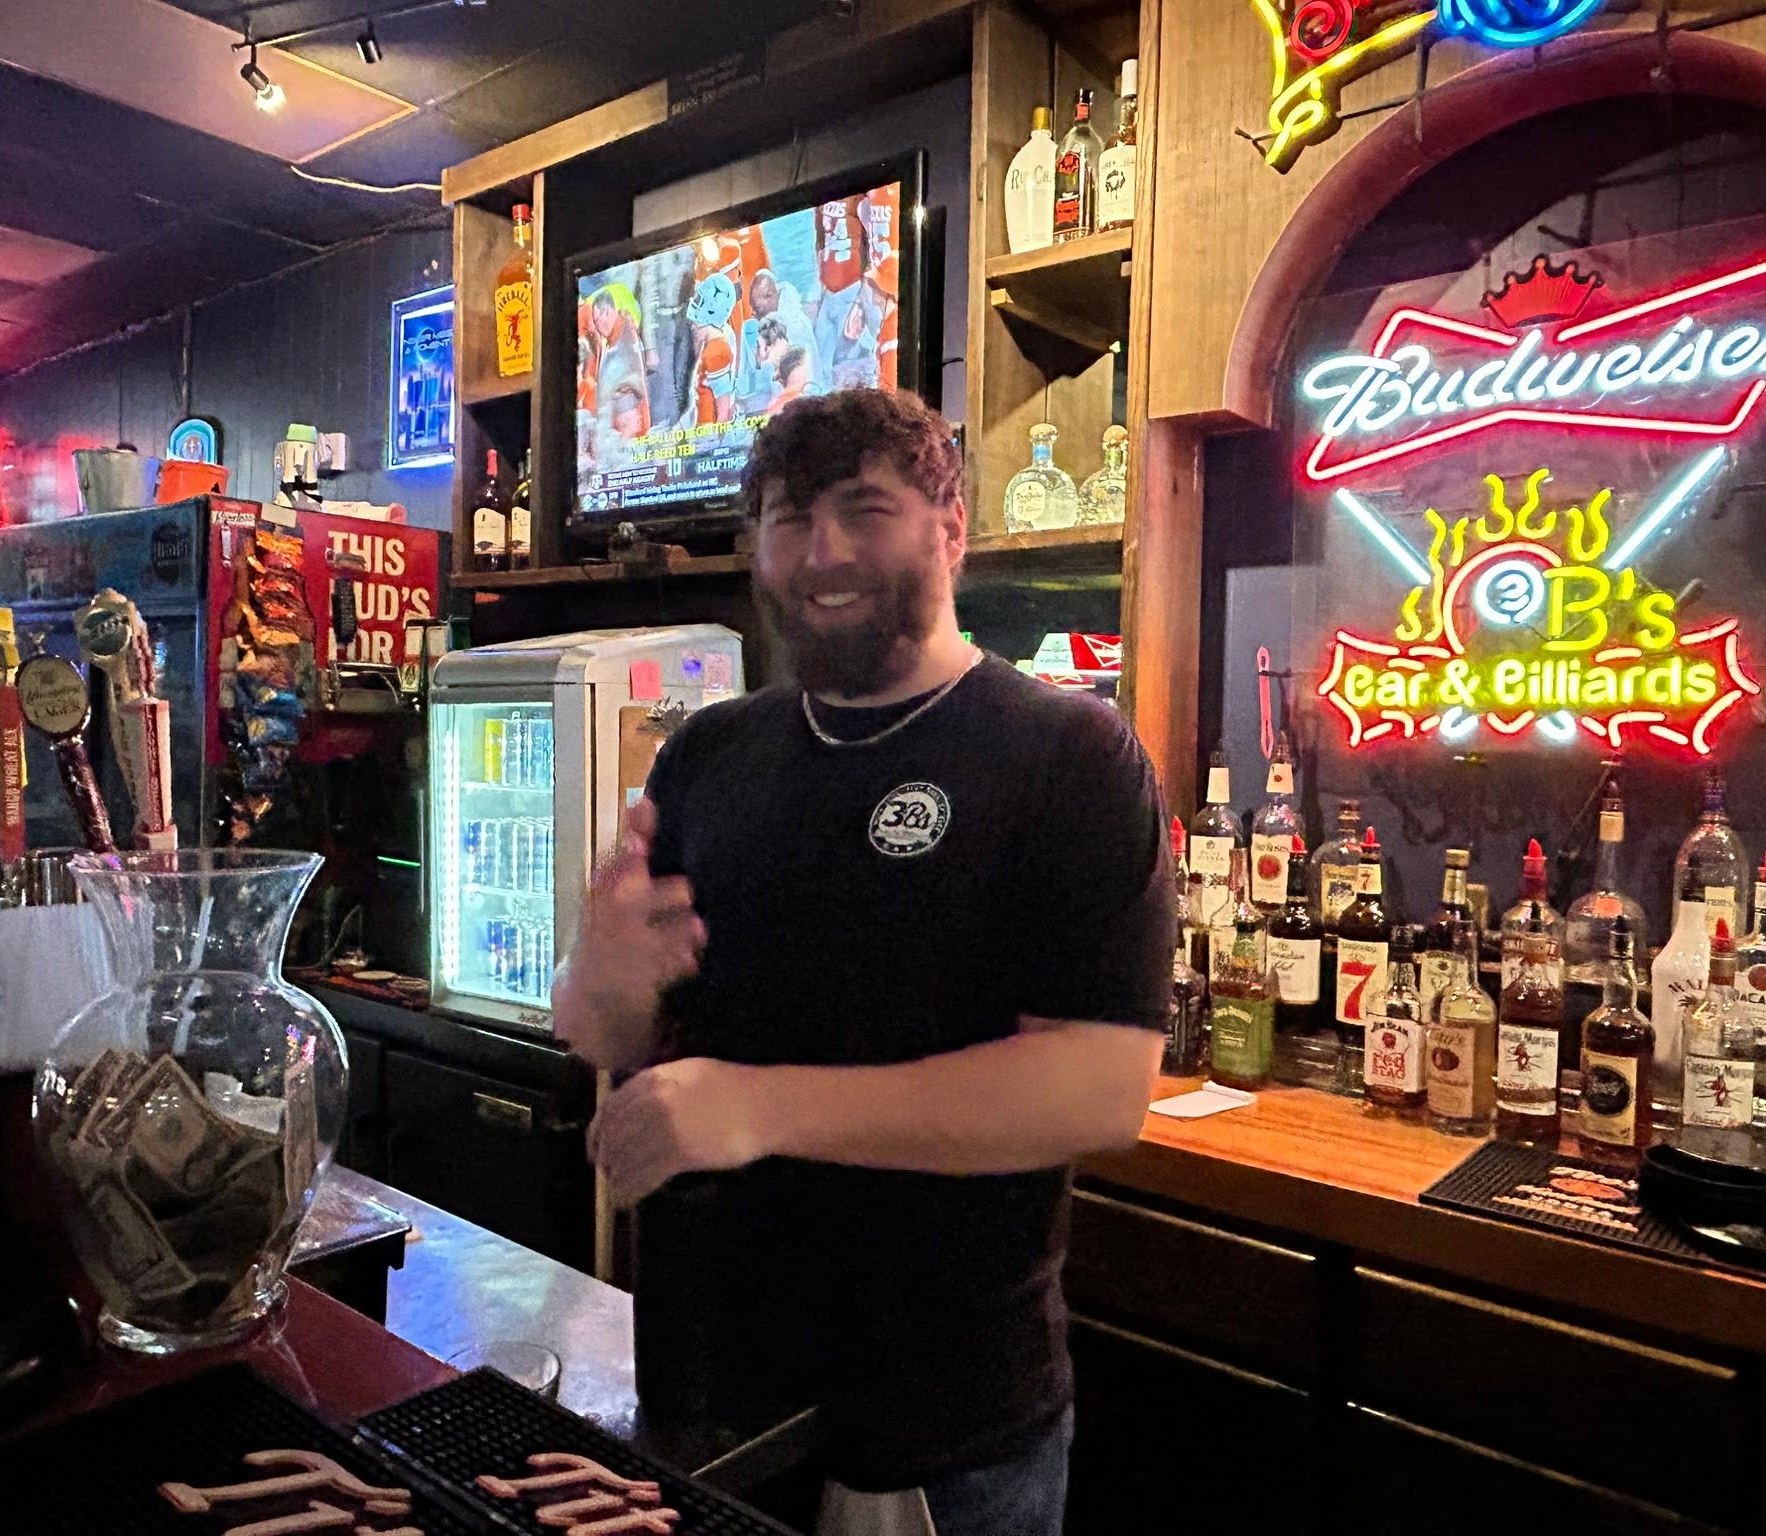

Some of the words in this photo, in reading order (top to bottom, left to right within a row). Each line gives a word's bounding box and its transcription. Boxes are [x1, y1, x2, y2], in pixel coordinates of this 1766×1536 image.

[1302, 317, 1766, 437] Budweise
[328, 531, 405, 576] THIS
[1438, 658, 1480, 706] &
[1360, 872, 1372, 891] 7
[1340, 961, 1377, 1020] 7
